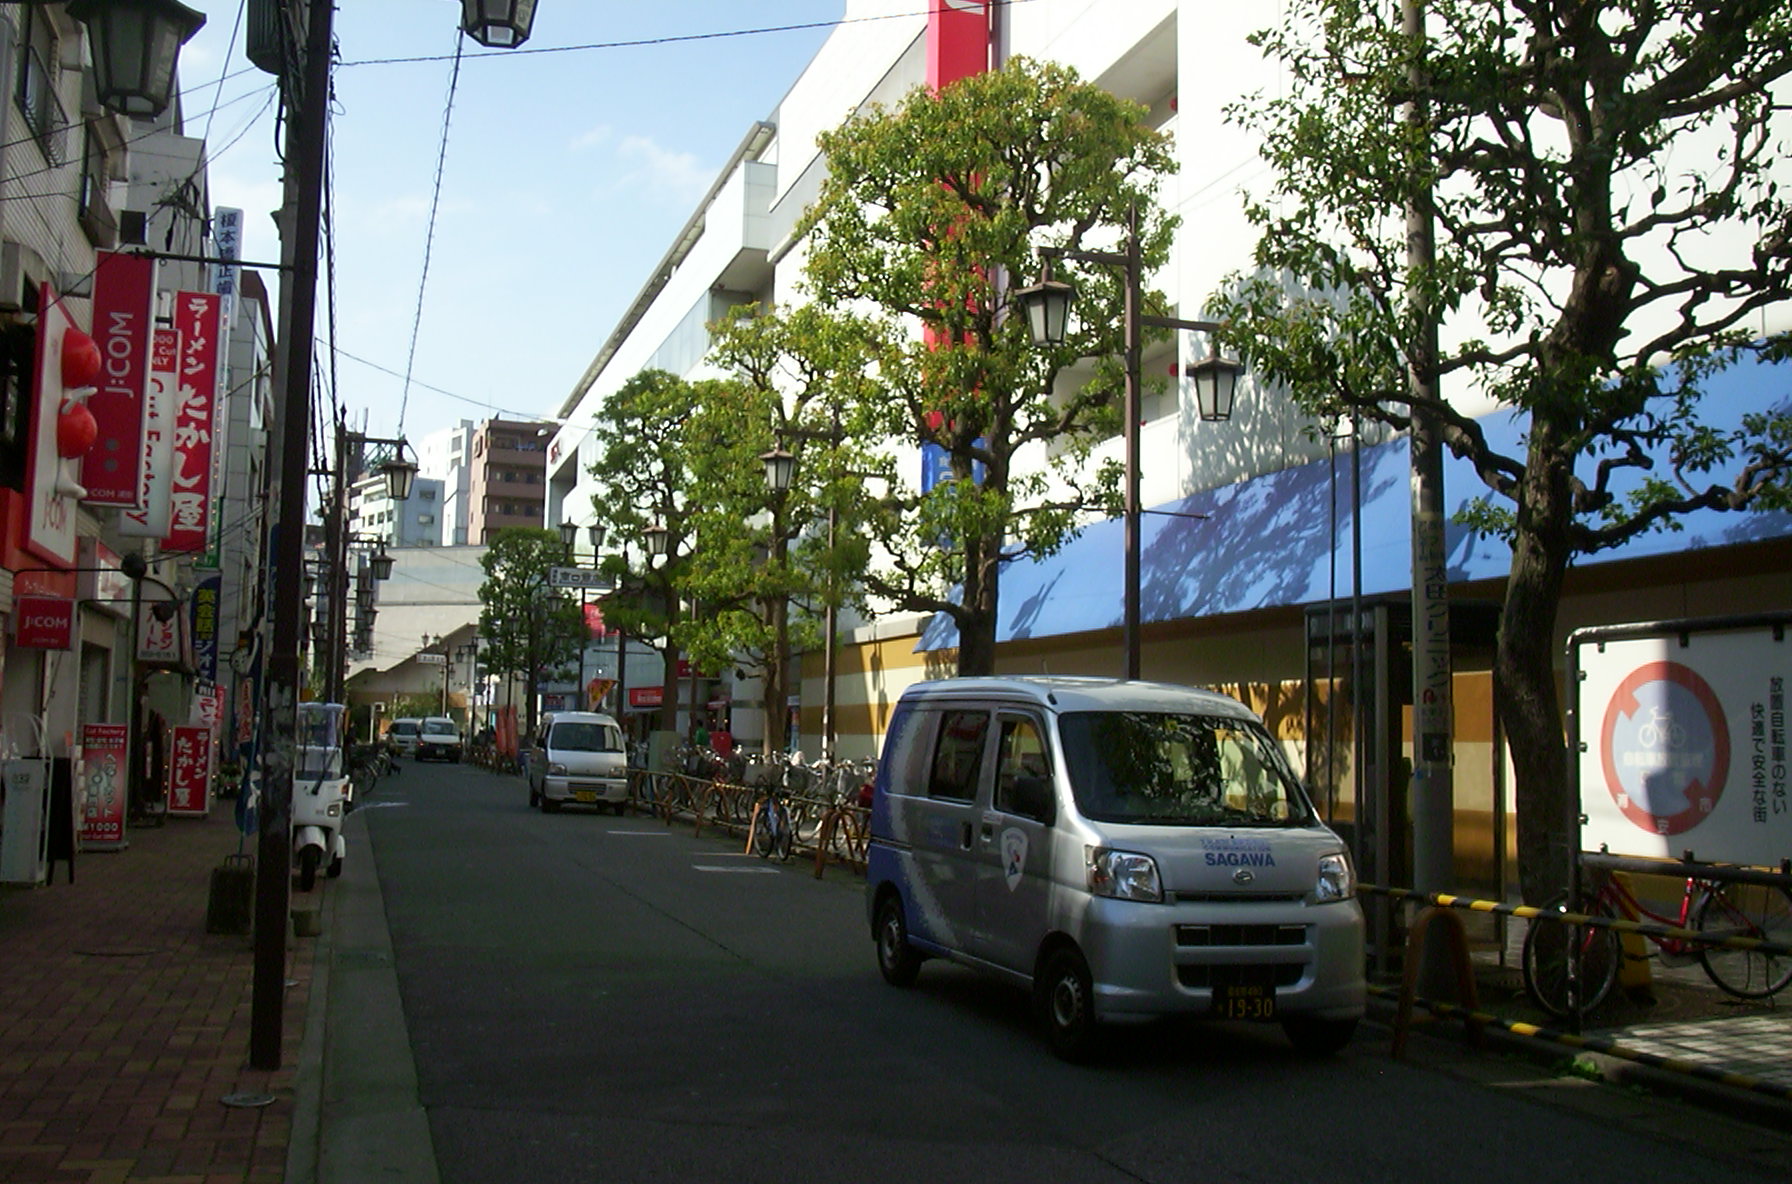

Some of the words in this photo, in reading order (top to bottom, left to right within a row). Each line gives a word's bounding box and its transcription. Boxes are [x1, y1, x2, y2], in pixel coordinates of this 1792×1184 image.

[105, 312, 134, 398] J:COM
[184, 298, 209, 374] ラーメン
[170, 384, 211, 532] たかし屋
[24, 616, 68, 629] J:COM
[193, 731, 209, 779] ラーメン
[1750, 702, 1767, 823] 快適で安全な街
[1205, 853, 1276, 867] SAGAWA
